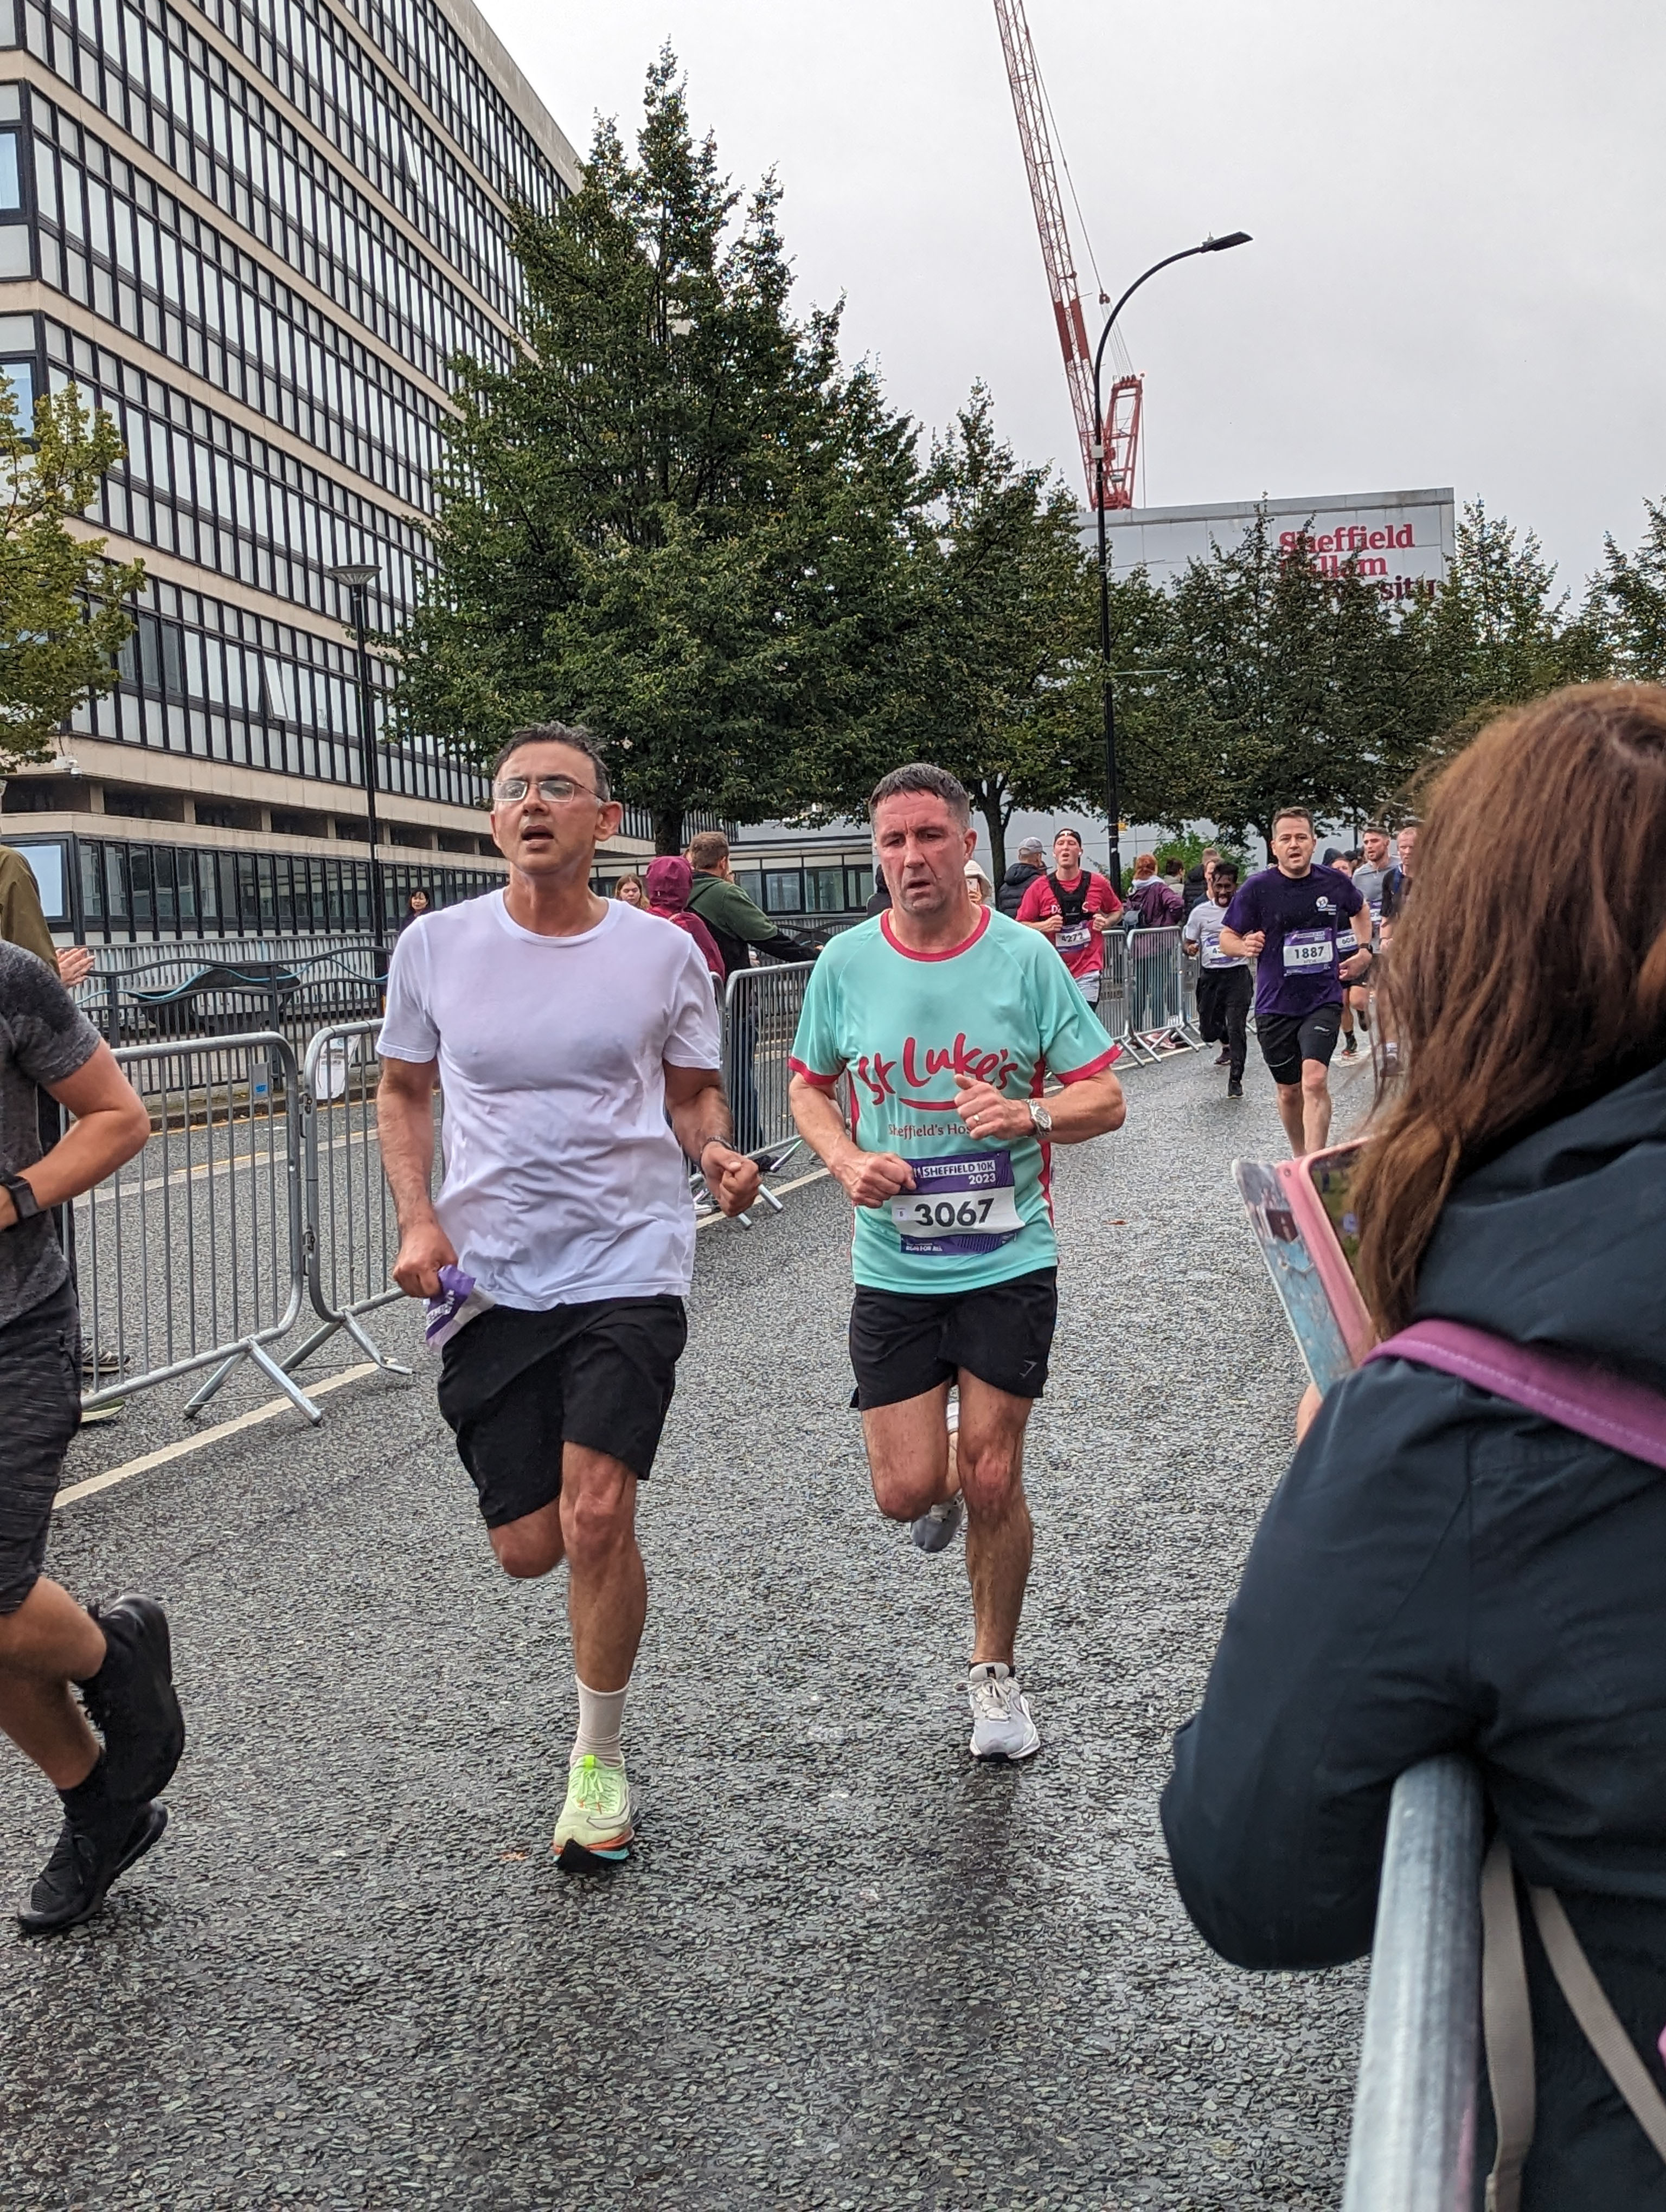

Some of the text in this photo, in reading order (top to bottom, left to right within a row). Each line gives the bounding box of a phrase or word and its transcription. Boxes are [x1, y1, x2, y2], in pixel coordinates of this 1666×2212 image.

[1295, 946, 1324, 959] 1887
[857, 1032, 1018, 1105] St Luke's
[888, 1123, 971, 1139] Sheffield's Hos
[924, 1163, 976, 1177] SHEFFIELD
[978, 1161, 995, 1172] 10K
[968, 1173, 996, 1185] 2023
[914, 1197, 995, 1227] 3067
